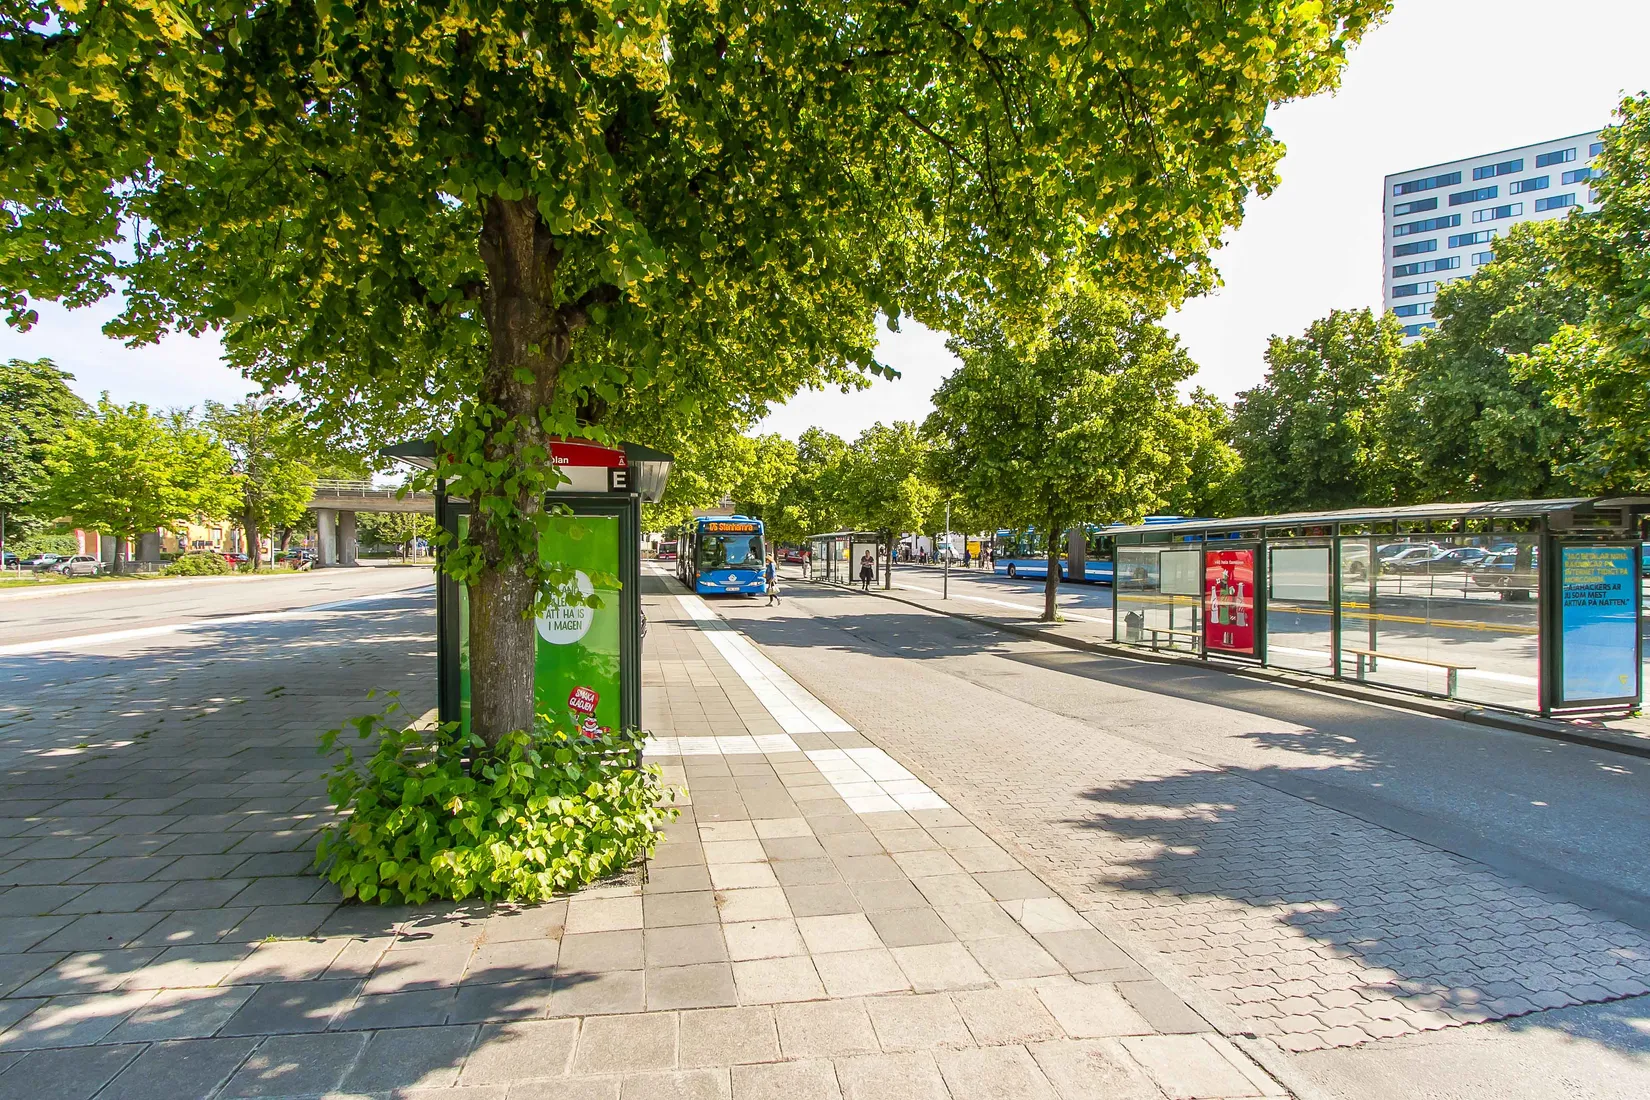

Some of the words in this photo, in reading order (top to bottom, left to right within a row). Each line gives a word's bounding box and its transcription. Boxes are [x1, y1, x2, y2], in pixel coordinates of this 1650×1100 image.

[613, 471, 627, 488] E
[546, 609, 560, 619] ATT
[563, 609, 575, 619] HA
[578, 609, 585, 618] IS
[554, 620, 582, 631] MAGEN
